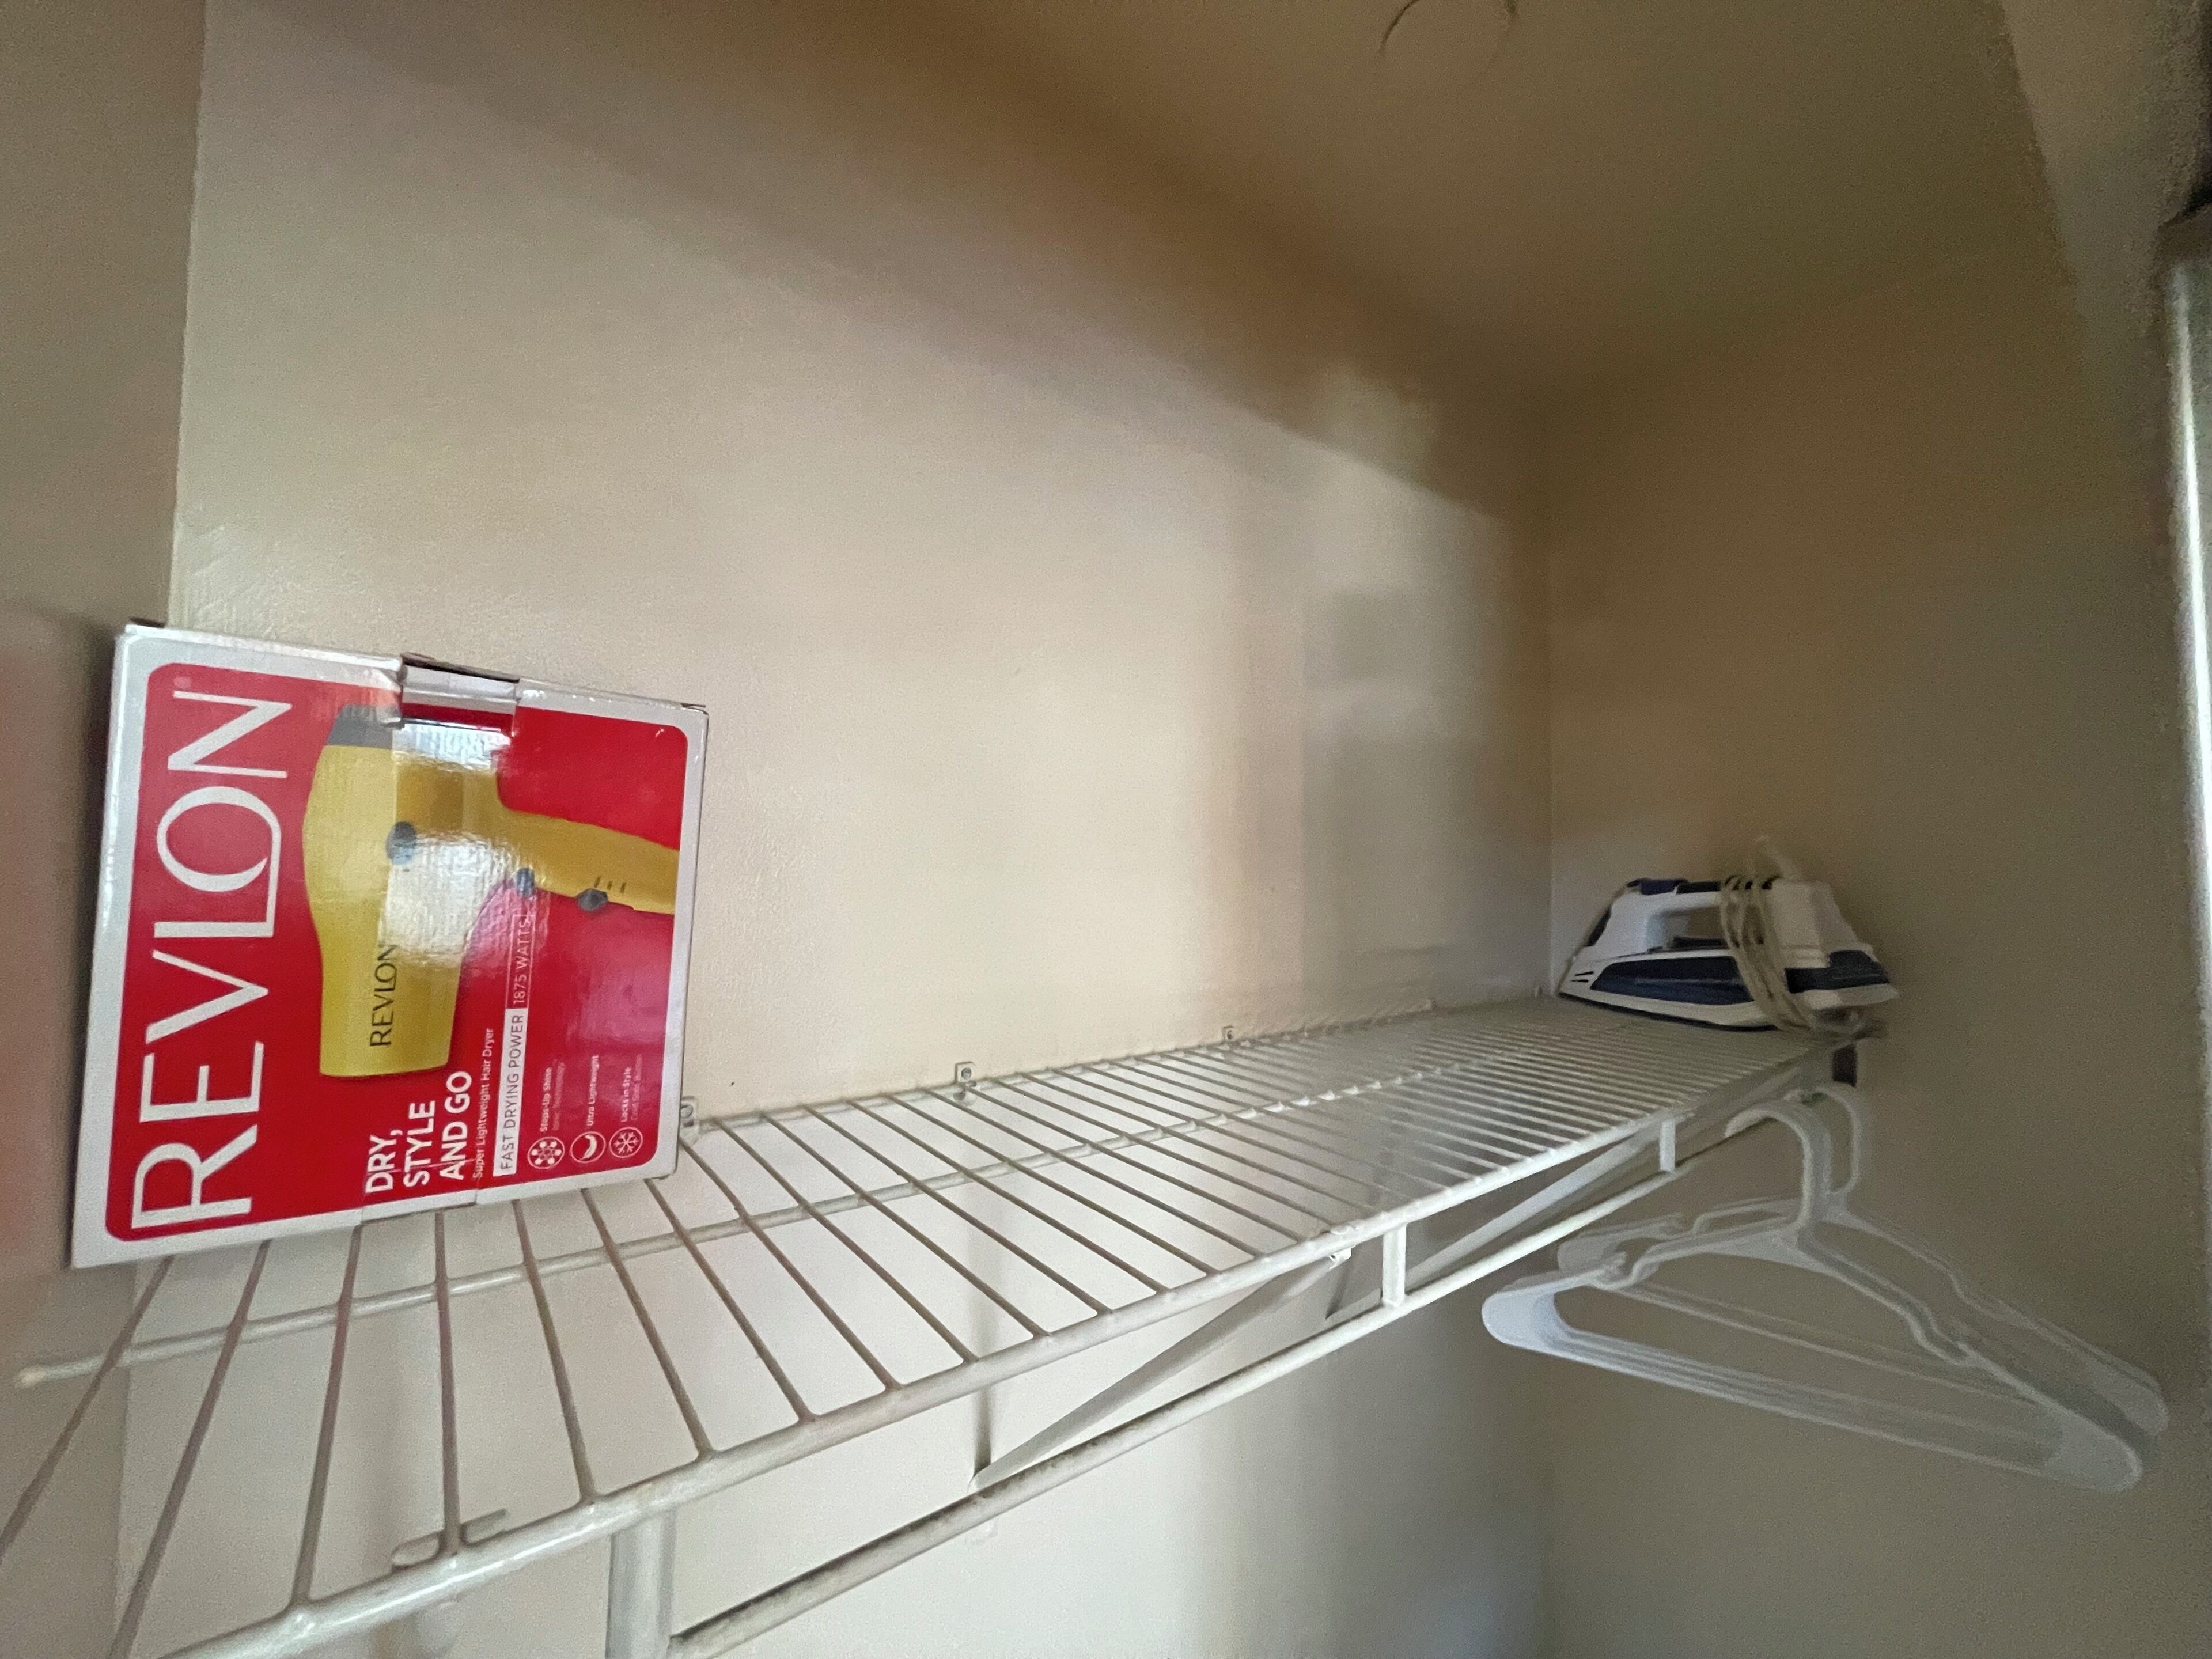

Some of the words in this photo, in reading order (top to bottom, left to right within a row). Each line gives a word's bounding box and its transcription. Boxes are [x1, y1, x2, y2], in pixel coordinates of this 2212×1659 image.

[131, 690, 292, 1230] REVLON
[516, 919, 531, 971] WATTS
[369, 945, 397, 1047] REVLON
[513, 974, 527, 1005] 1875
[482, 1028, 494, 1057] Dryer
[508, 1014, 524, 1068] POWER
[444, 1070, 472, 1114] GO
[480, 1059, 491, 1081] Hair
[623, 1067, 632, 1088] Style
[476, 1084, 490, 1146] Lightweight
[503, 1073, 519, 1130] DRYING
[586, 1107, 594, 1127] Ultra
[366, 1128, 403, 1194] DRY,
[404, 1100, 435, 1187] STYLE
[440, 1116, 468, 1180] AND
[472, 1149, 484, 1179] Super
[500, 1135, 514, 1170] FAST
